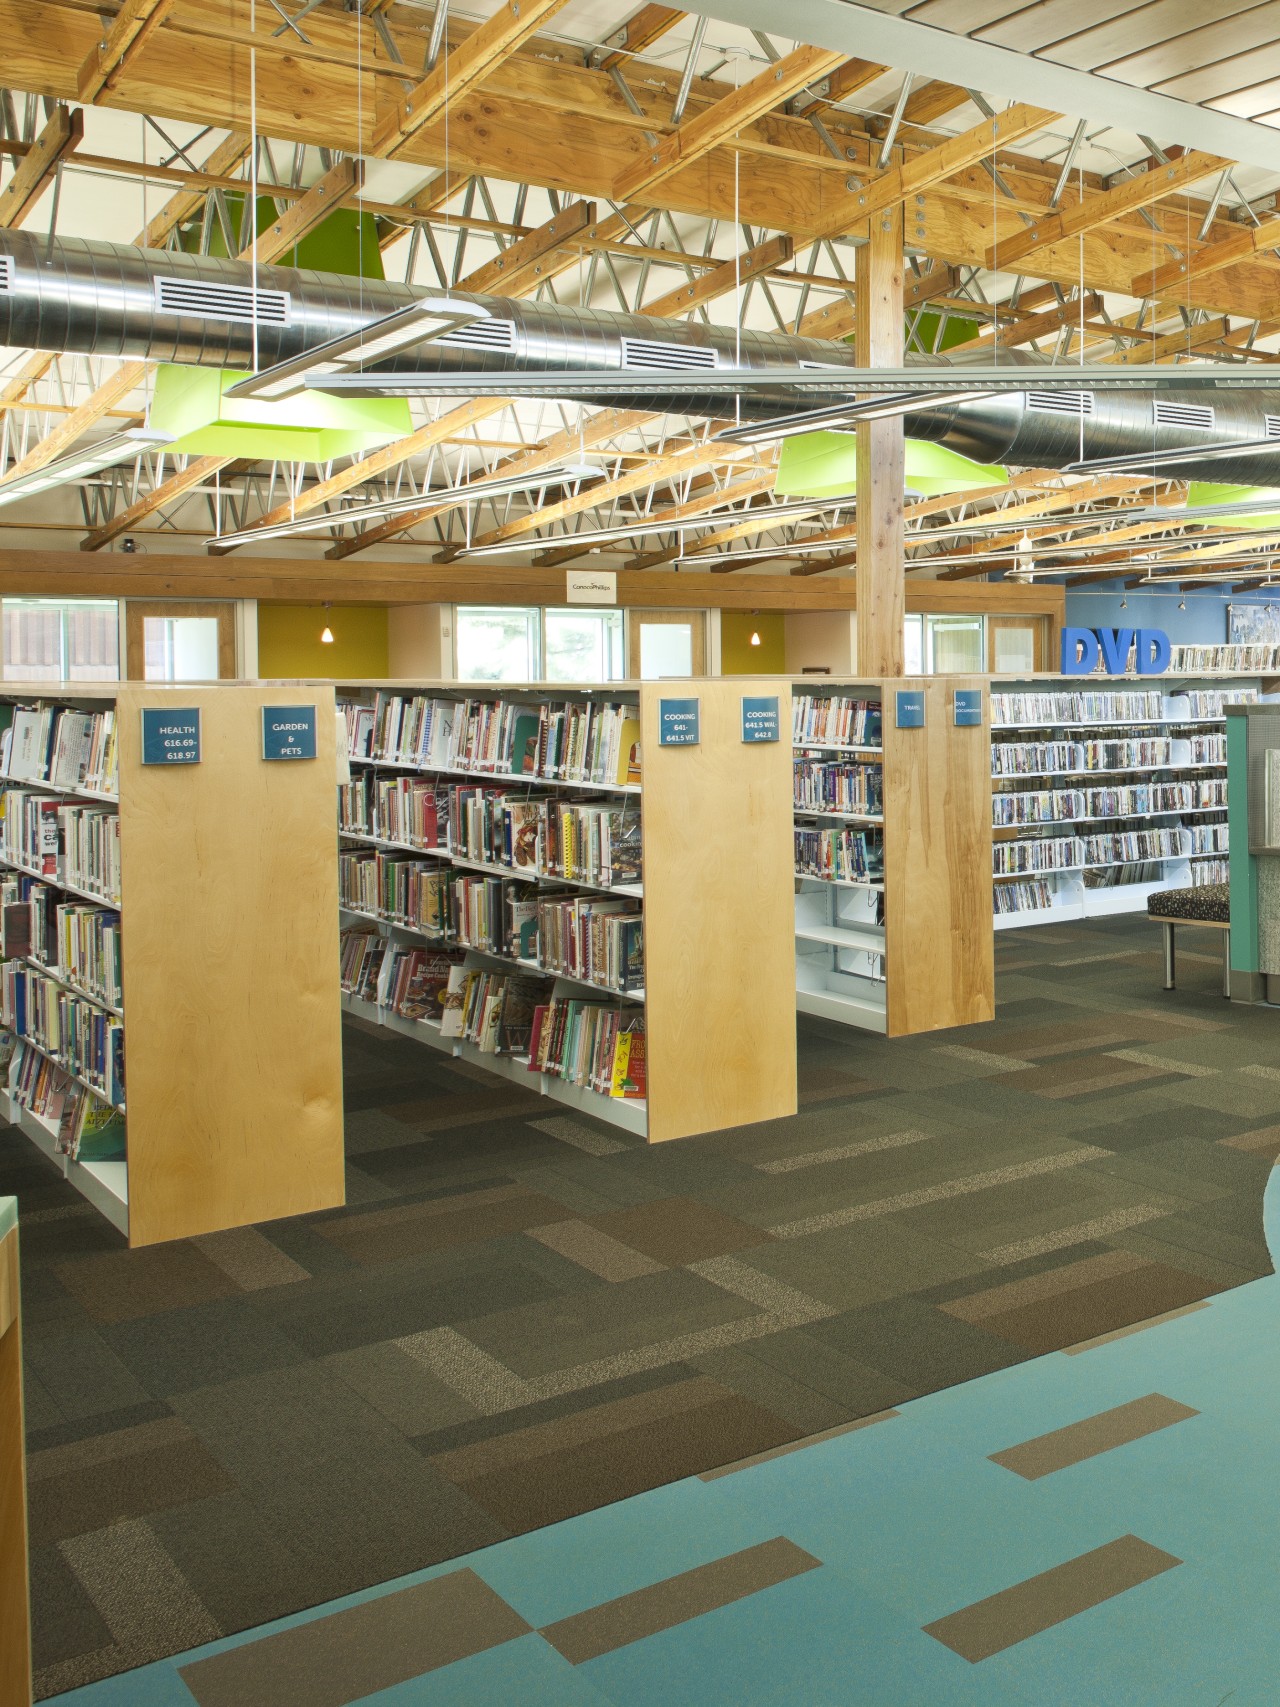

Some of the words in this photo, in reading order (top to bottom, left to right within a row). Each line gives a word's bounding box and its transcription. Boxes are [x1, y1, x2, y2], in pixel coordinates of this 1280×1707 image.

[572, 583, 611, 591] ConocoPhillips
[1061, 627, 1171, 675] DVD
[664, 713, 696, 721] COOKING
[747, 711, 777, 719] COOKING
[159, 726, 196, 735] HEALTH
[272, 723, 309, 731] GARDEN
[164, 739, 197, 747] 616.69-
[288, 735, 295, 743] &
[280, 747, 302, 755] PETS
[167, 751, 196, 760] 618.97
